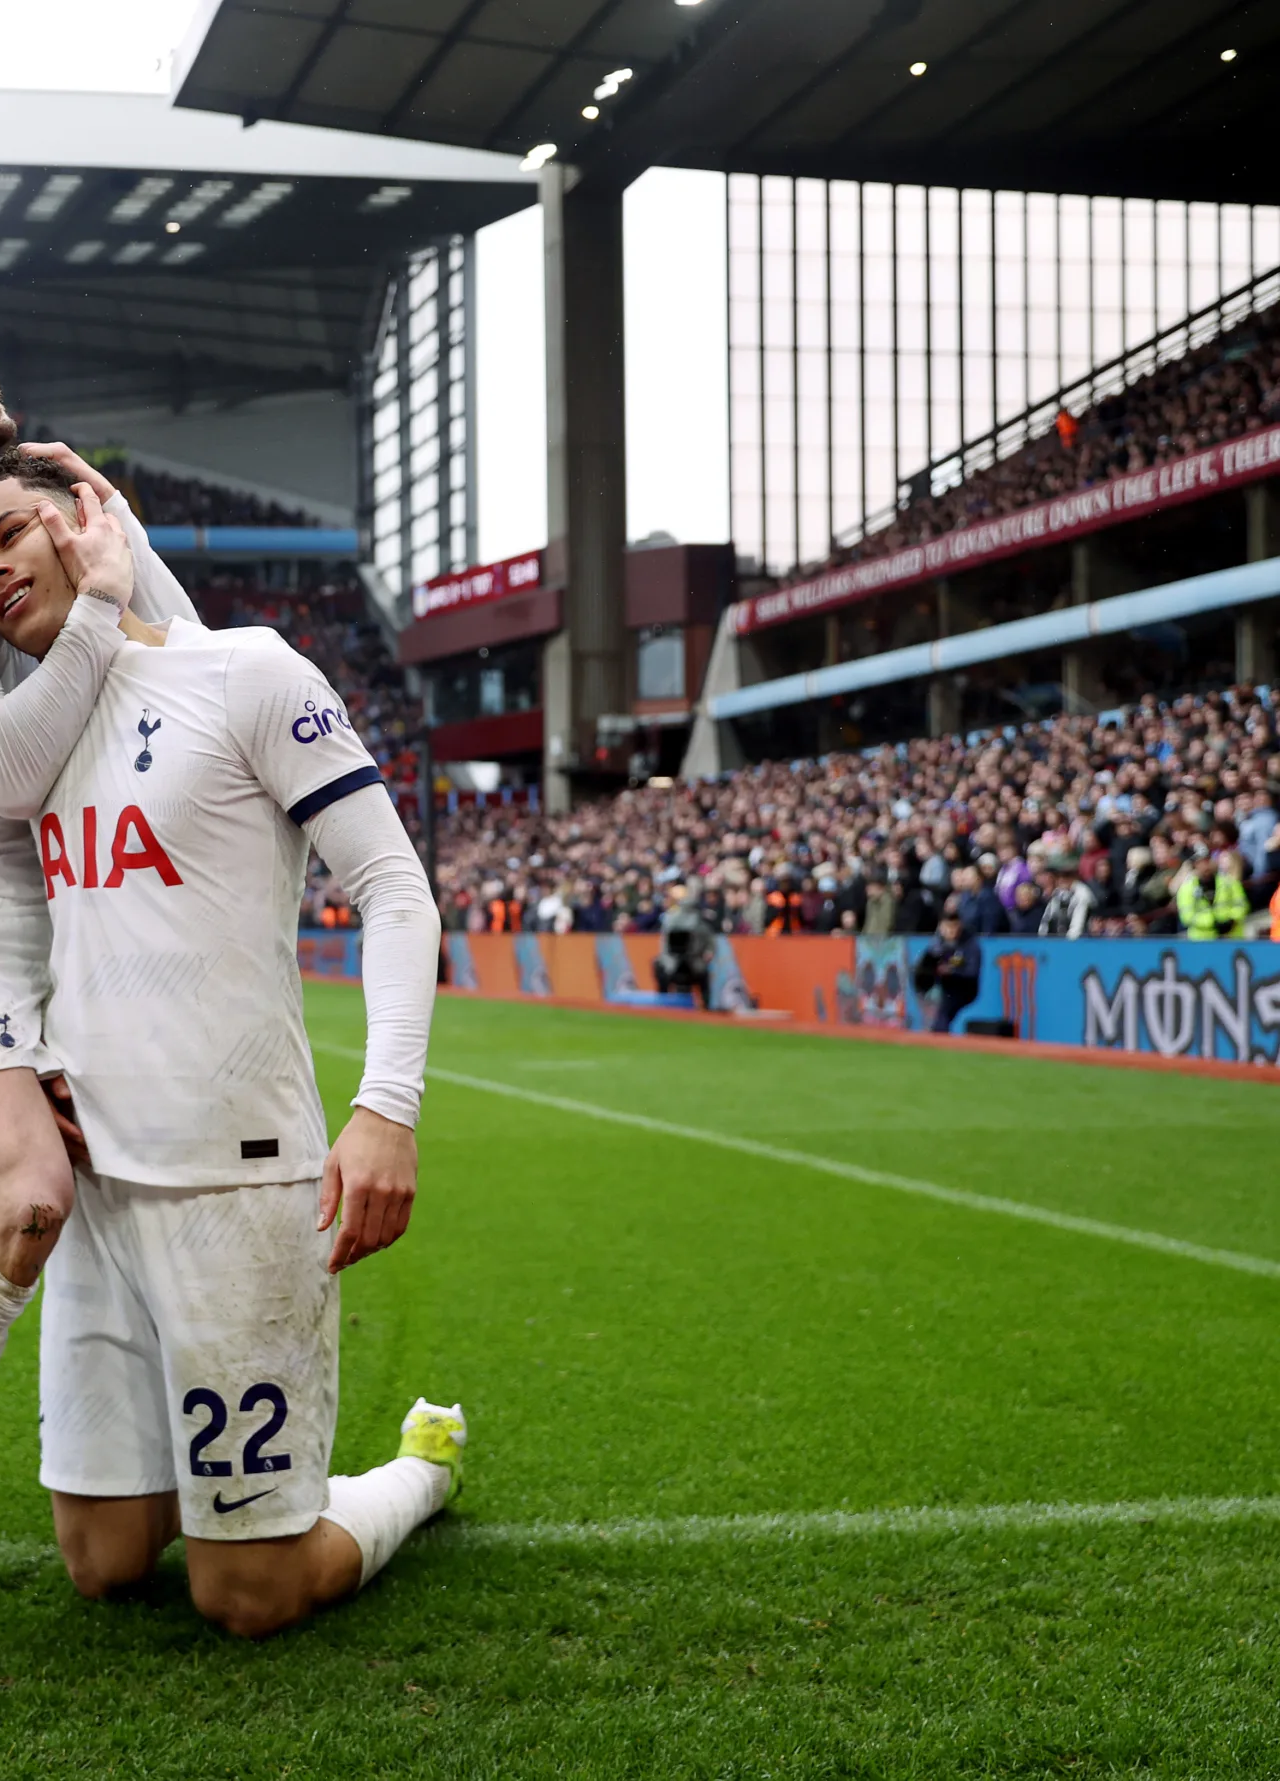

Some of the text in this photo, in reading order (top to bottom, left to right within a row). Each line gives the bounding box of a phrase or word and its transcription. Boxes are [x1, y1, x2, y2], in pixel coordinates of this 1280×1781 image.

[1048, 483, 1111, 531] DOWN
[1113, 470, 1158, 510] THE
[1159, 451, 1219, 498] LEFT,
[40, 805, 184, 900] AIA
[183, 1382, 291, 1477] 22
